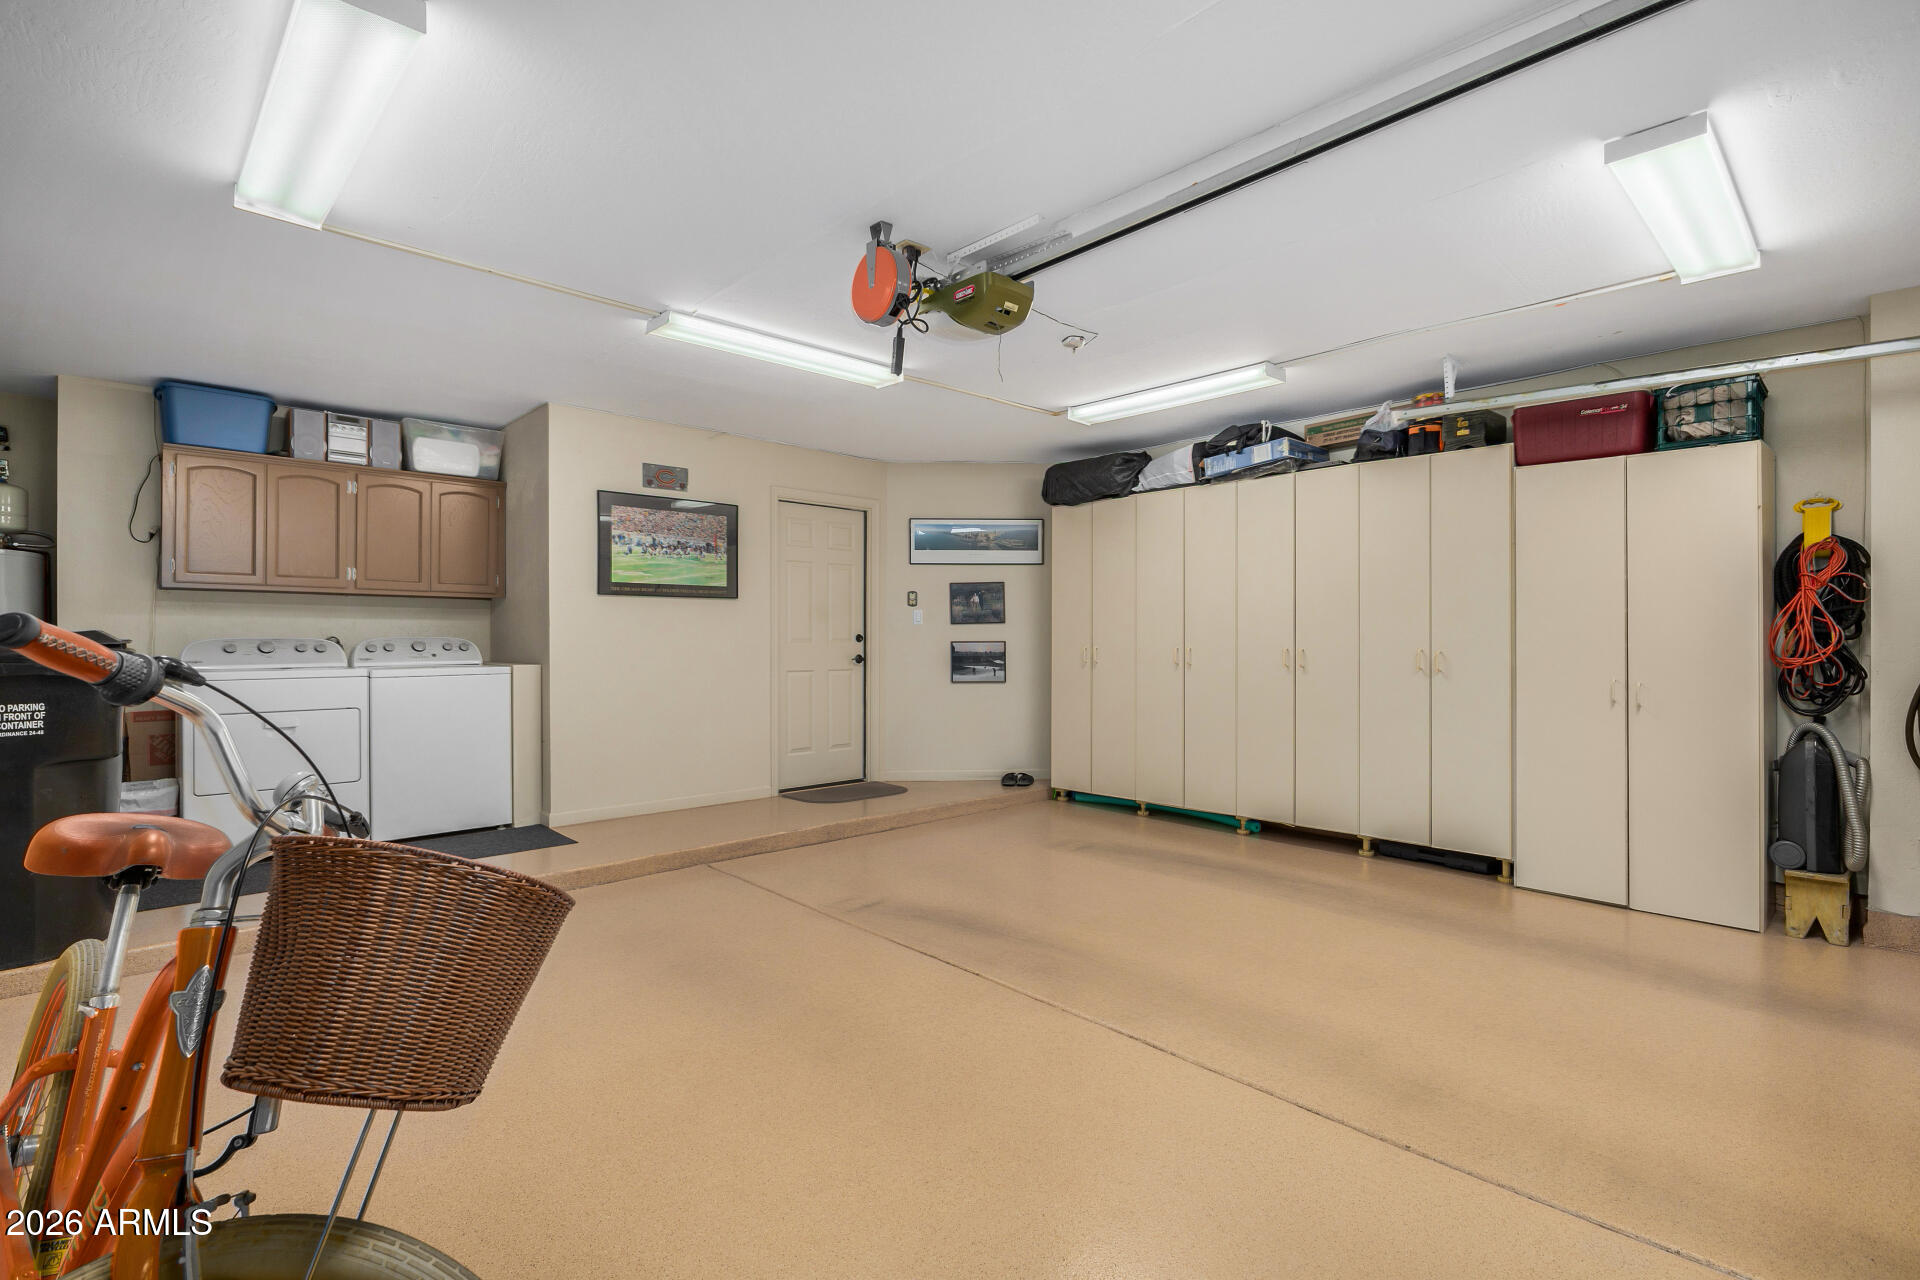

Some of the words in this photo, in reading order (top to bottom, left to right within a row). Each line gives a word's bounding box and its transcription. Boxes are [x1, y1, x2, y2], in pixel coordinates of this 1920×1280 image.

[7, 702, 46, 712] PARKING
[3, 712, 32, 721] FRONT
[33, 711, 46, 720] OF
[0, 720, 44, 730] ONTAINER
